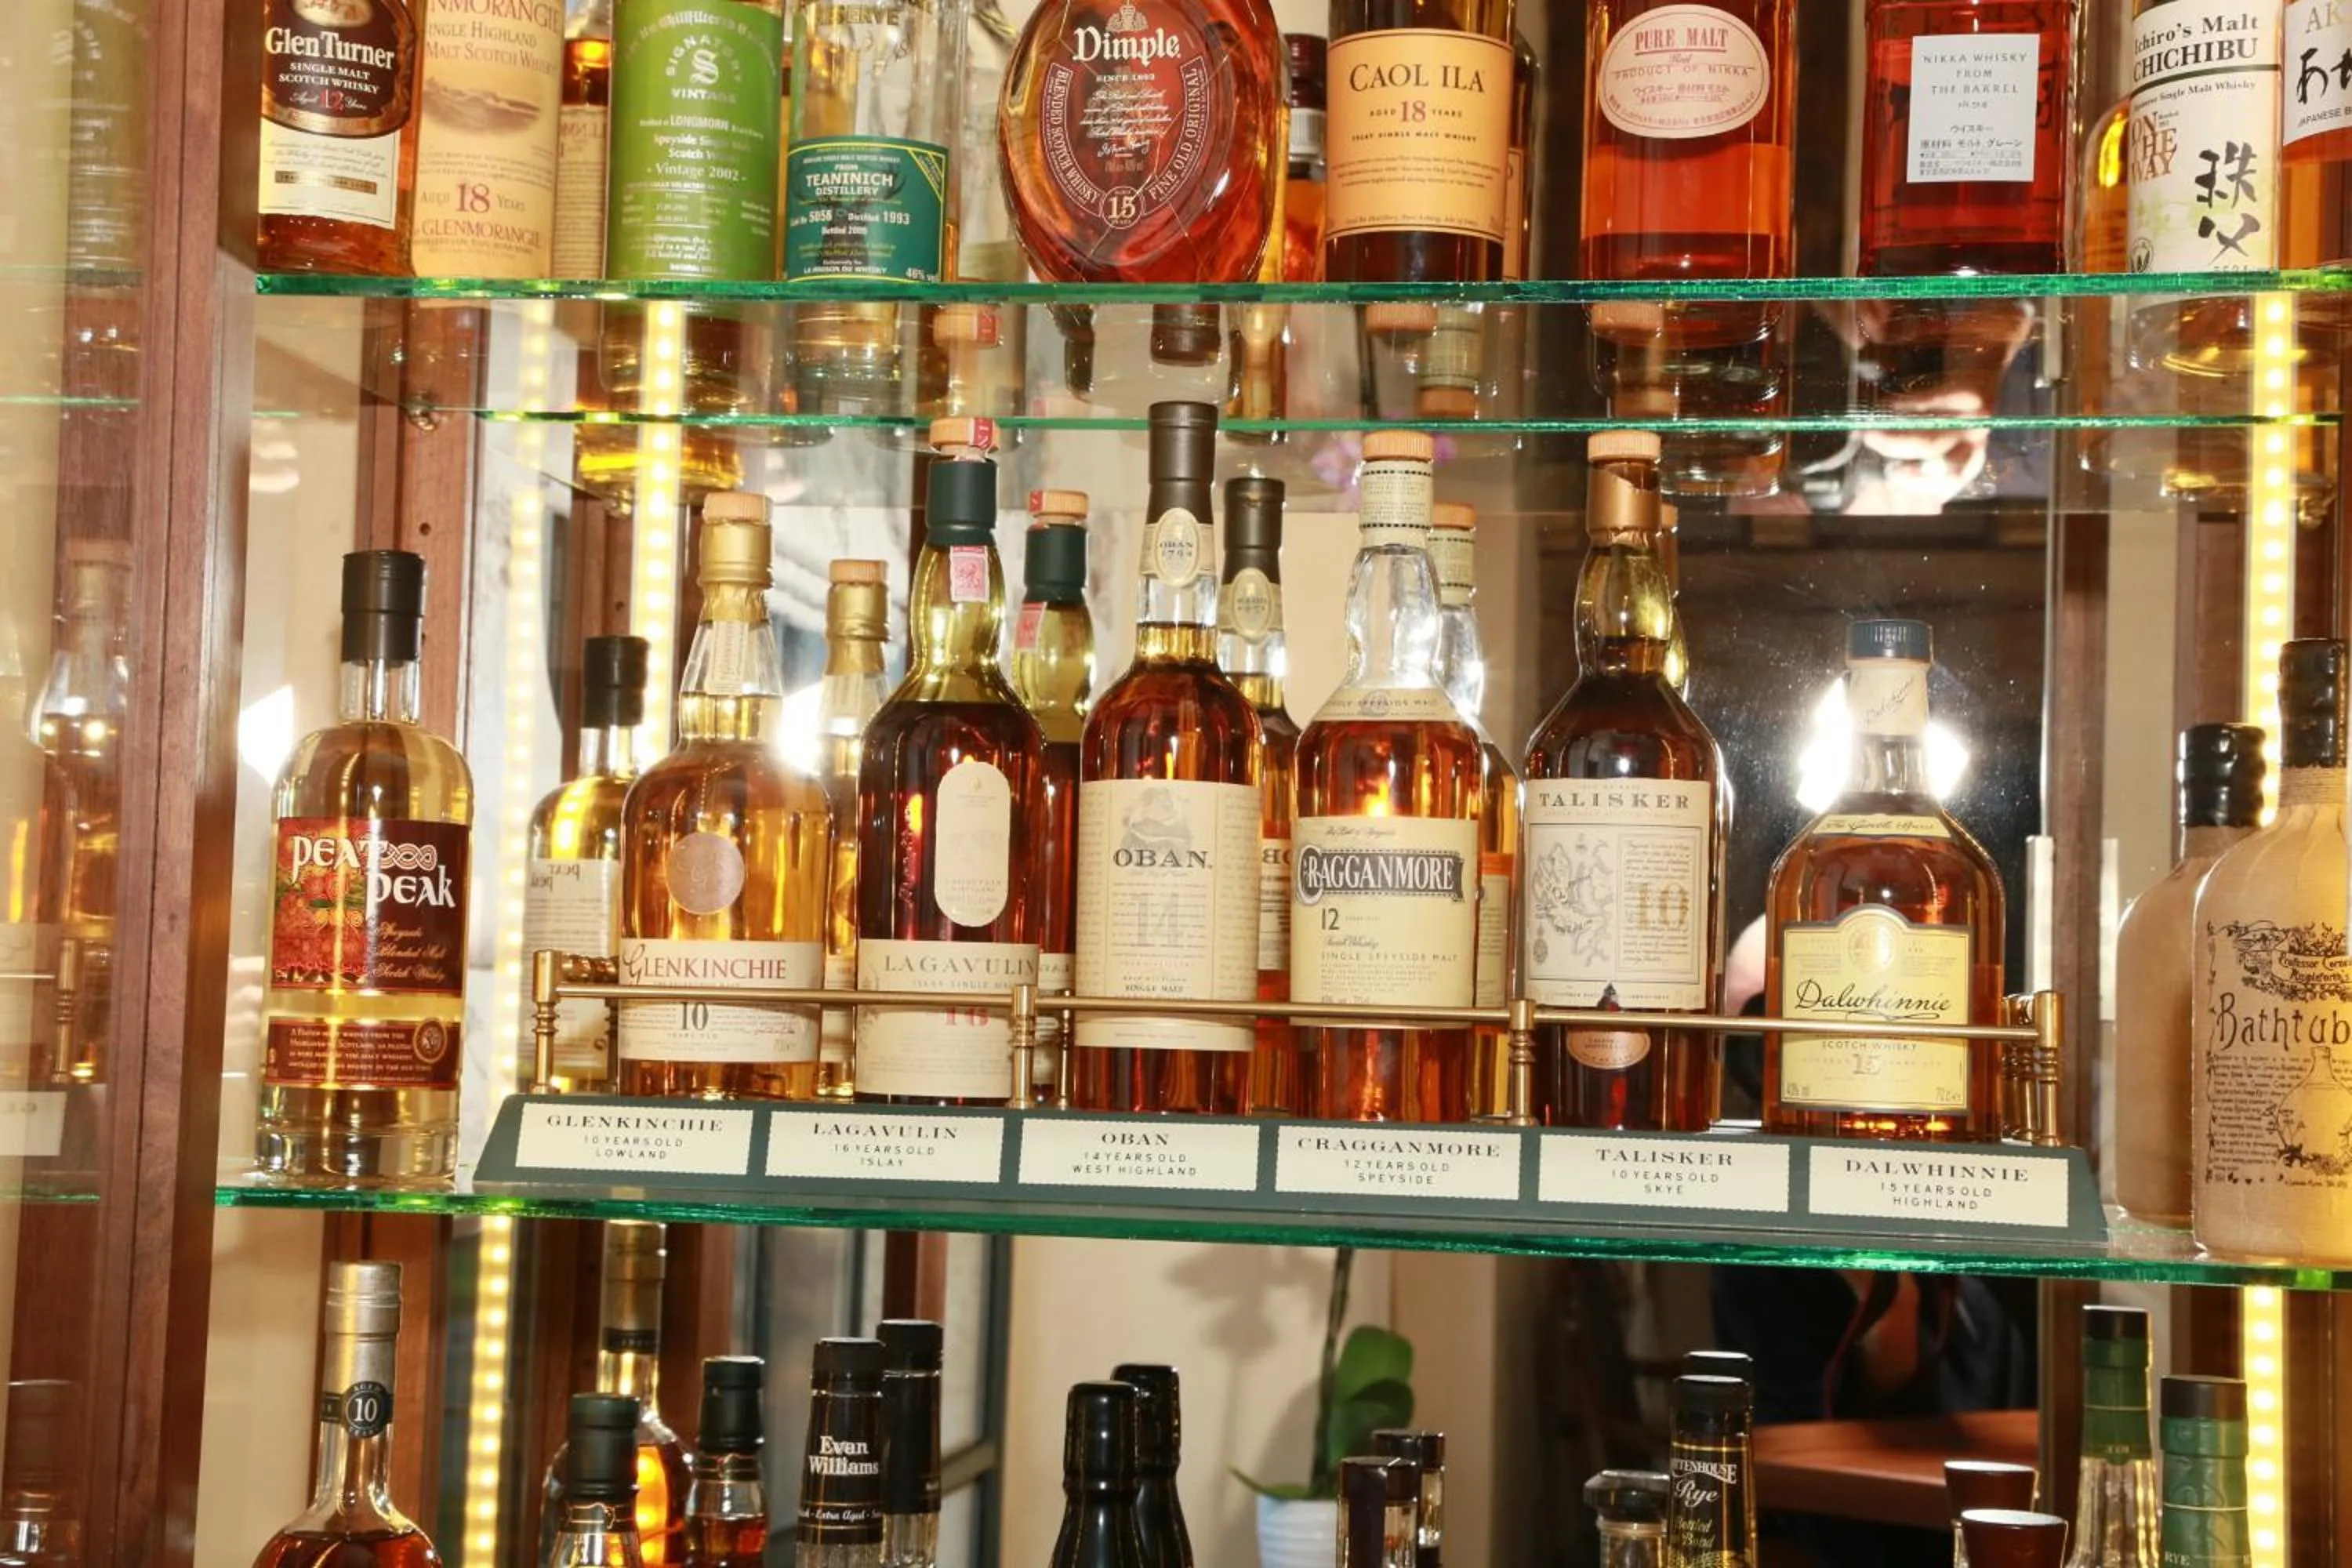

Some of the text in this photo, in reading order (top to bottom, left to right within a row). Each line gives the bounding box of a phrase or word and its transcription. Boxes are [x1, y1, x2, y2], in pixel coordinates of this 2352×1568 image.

[471, 21, 537, 48] HIGHLAND
[1635, 27, 1729, 50] PURE MALT
[2134, 13, 2258, 55] Ichiro's Malt
[426, 42, 517, 64] MALT SCOTCH
[1073, 26, 1181, 67] Dimple
[1923, 53, 2027, 64] NIKKA WHISKY
[2132, 38, 2258, 82] CHICHIBU
[289, 62, 371, 80] SINGLE MALT
[1349, 64, 1485, 93] CAOL ILA
[1617, 65, 1672, 79] PRODUCT
[1708, 65, 1748, 77] NIKKA
[1956, 69, 1992, 78] FROM
[279, 74, 380, 95] SCOTCH WHISKY
[1932, 84, 2019, 95] THE BARREL
[2188, 84, 2212, 94] Malt
[2216, 80, 2256, 91] Whisky
[320, 89, 344, 112] 12
[1051, 70, 1069, 125] BLENDED
[1370, 100, 1462, 122] AGED 18 YEARS
[2298, 108, 2341, 128] JAPANESE
[1149, 68, 1200, 201] FINE OLD ORIGINAL
[1052, 127, 1073, 170] SCOTCH
[655, 163, 739, 180] Vintage 2002
[805, 172, 893, 187] TEANINICH
[815, 186, 879, 196] DISTILLERY
[1065, 167, 1099, 204] WHISKY
[456, 183, 491, 214] 18
[1108, 196, 1135, 219] 15
[883, 211, 910, 225] 1993
[1539, 792, 1690, 809] TALISKER
[1298, 844, 1454, 906] CRAGGANMORE
[1638, 882, 1690, 931] 10
[1321, 908, 1340, 931] 12
[622, 943, 786, 985] GLENKINCHIE
[885, 954, 1038, 975] LAGAVULIN
[1321, 951, 1359, 960] SINGLE
[1795, 978, 1951, 1012] Dalwhinnie
[680, 1001, 709, 1030] 10
[2216, 992, 2350, 1051] Bathtub
[1822, 1040, 1918, 1051] SCOTCH WHISKY
[547, 1114, 723, 1131] GLENKINCHIE
[814, 1122, 959, 1139] LAGAVULIN
[584, 1136, 684, 1147] 10 YEARS OLD
[1101, 1133, 1170, 1145] OBAN
[1298, 1137, 1501, 1157] CRAGGANMORE
[596, 1149, 667, 1160] LOWLAND
[835, 1143, 935, 1156] 16 YEARS OLD
[1083, 1152, 1187, 1163] 14 YEARS OLD
[1595, 1149, 1733, 1166] TALISKER
[860, 1157, 904, 1167] ISLAY
[1073, 1164, 1197, 1175] WEST HIGHLAND
[1345, 1160, 1450, 1172] 12 YEARS OLD
[1846, 1159, 2029, 1182] DALWHINNIE
[1358, 1173, 1435, 1185] SPEYSIDE
[1612, 1170, 1719, 1183] 10 YEARS OLD
[1645, 1184, 1684, 1194] SKYE
[1881, 1182, 1992, 1197] 15 YEARS OLD
[1893, 1196, 1978, 1210] HIGHLAND
[354, 1398, 377, 1422] 10
[819, 1436, 869, 1455] Evan
[809, 1455, 879, 1475] Williams
[1671, 1458, 1737, 1483] TENHOUSE
[1675, 1479, 1719, 1507] Rye
